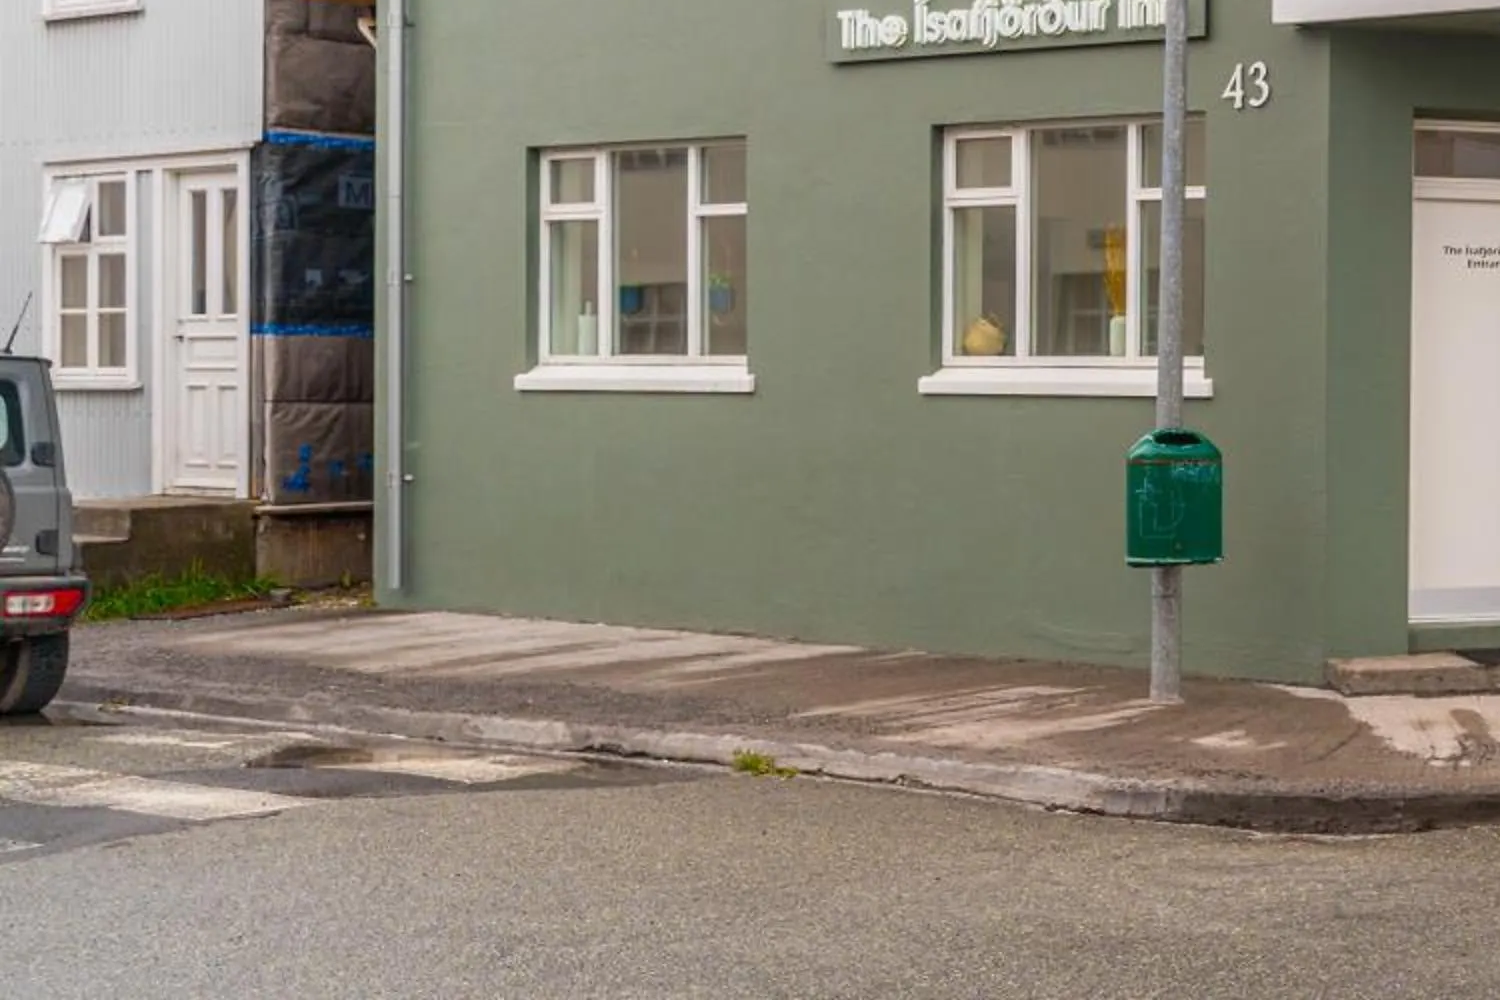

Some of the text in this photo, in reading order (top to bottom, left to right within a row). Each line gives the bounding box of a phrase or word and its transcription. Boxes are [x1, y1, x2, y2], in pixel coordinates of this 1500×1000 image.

[837, 9, 908, 49] The
[1221, 61, 1270, 109] 43
[1443, 245, 1463, 255] The
